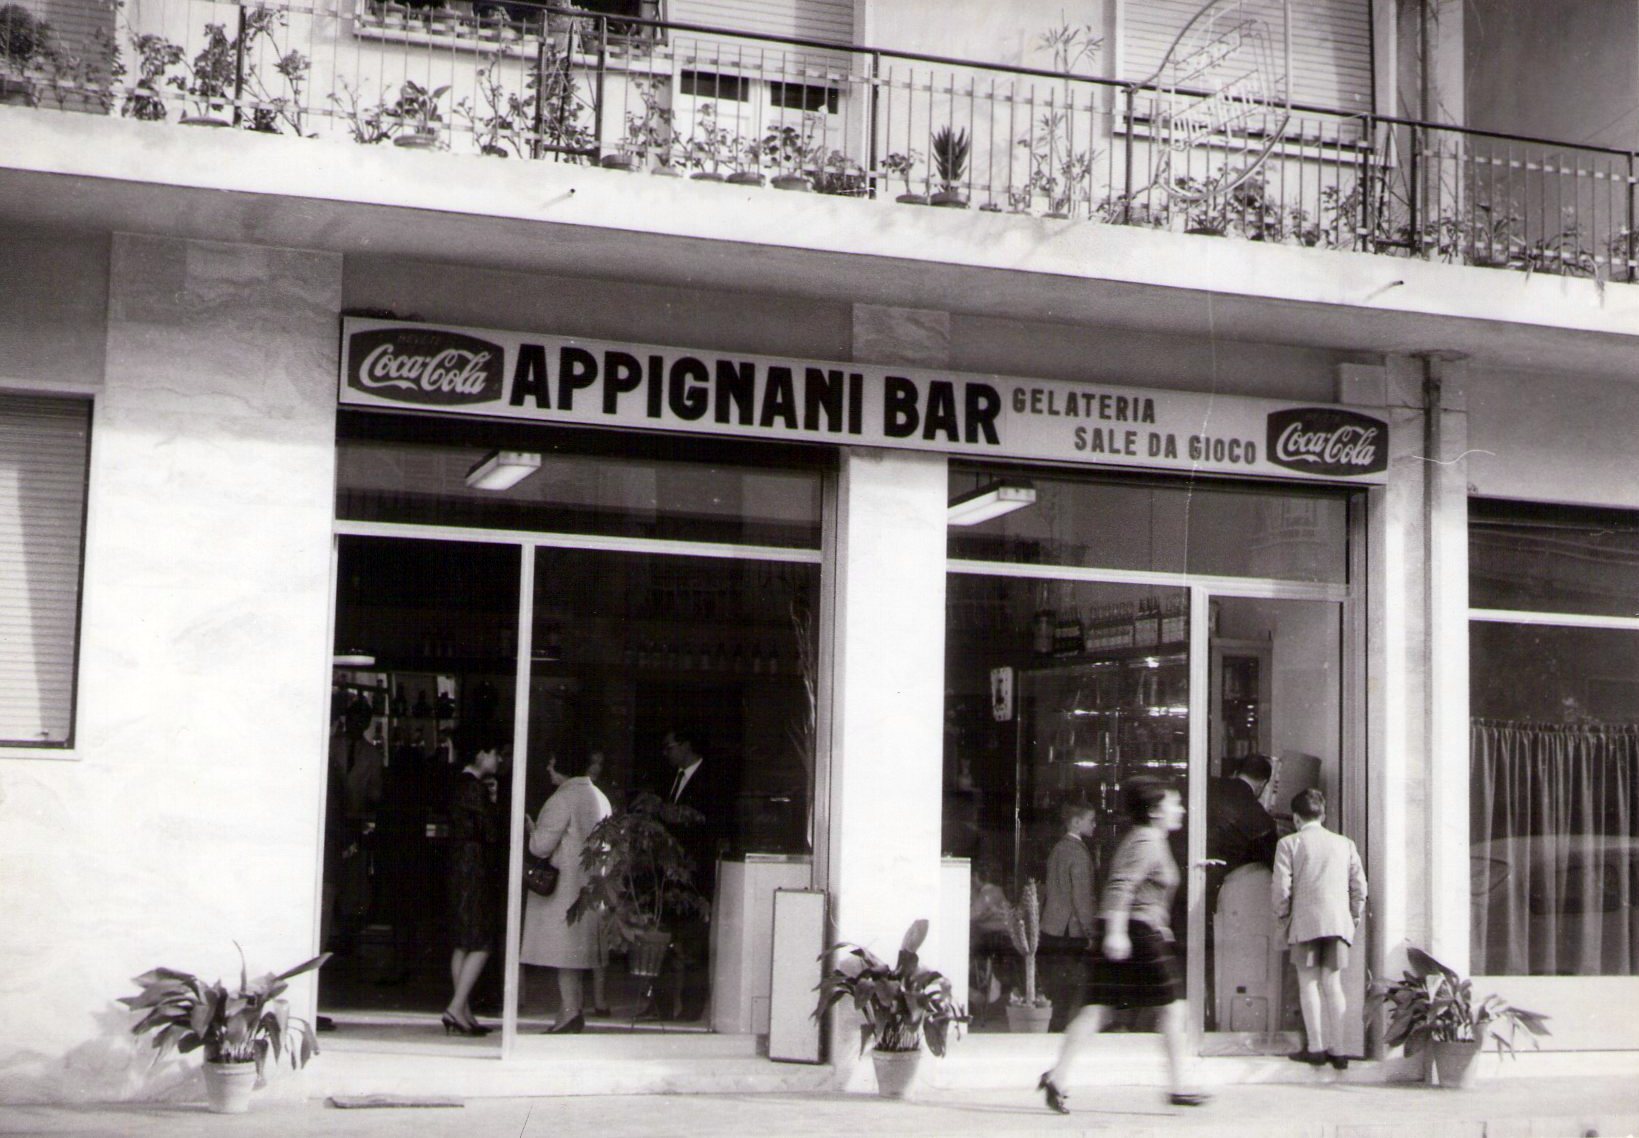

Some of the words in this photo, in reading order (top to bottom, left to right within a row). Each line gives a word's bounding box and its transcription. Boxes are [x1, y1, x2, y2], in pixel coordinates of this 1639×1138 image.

[359, 344, 488, 394] Coca-Cola
[509, 343, 863, 434] APPIGNANI
[884, 375, 1000, 445] BAR
[1012, 387, 1155, 424] GELATERIA
[1074, 426, 1137, 456] SALE
[1148, 432, 1178, 459] DA
[1188, 437, 1256, 465] GIOCO
[1276, 421, 1378, 466] Coca-Cola
